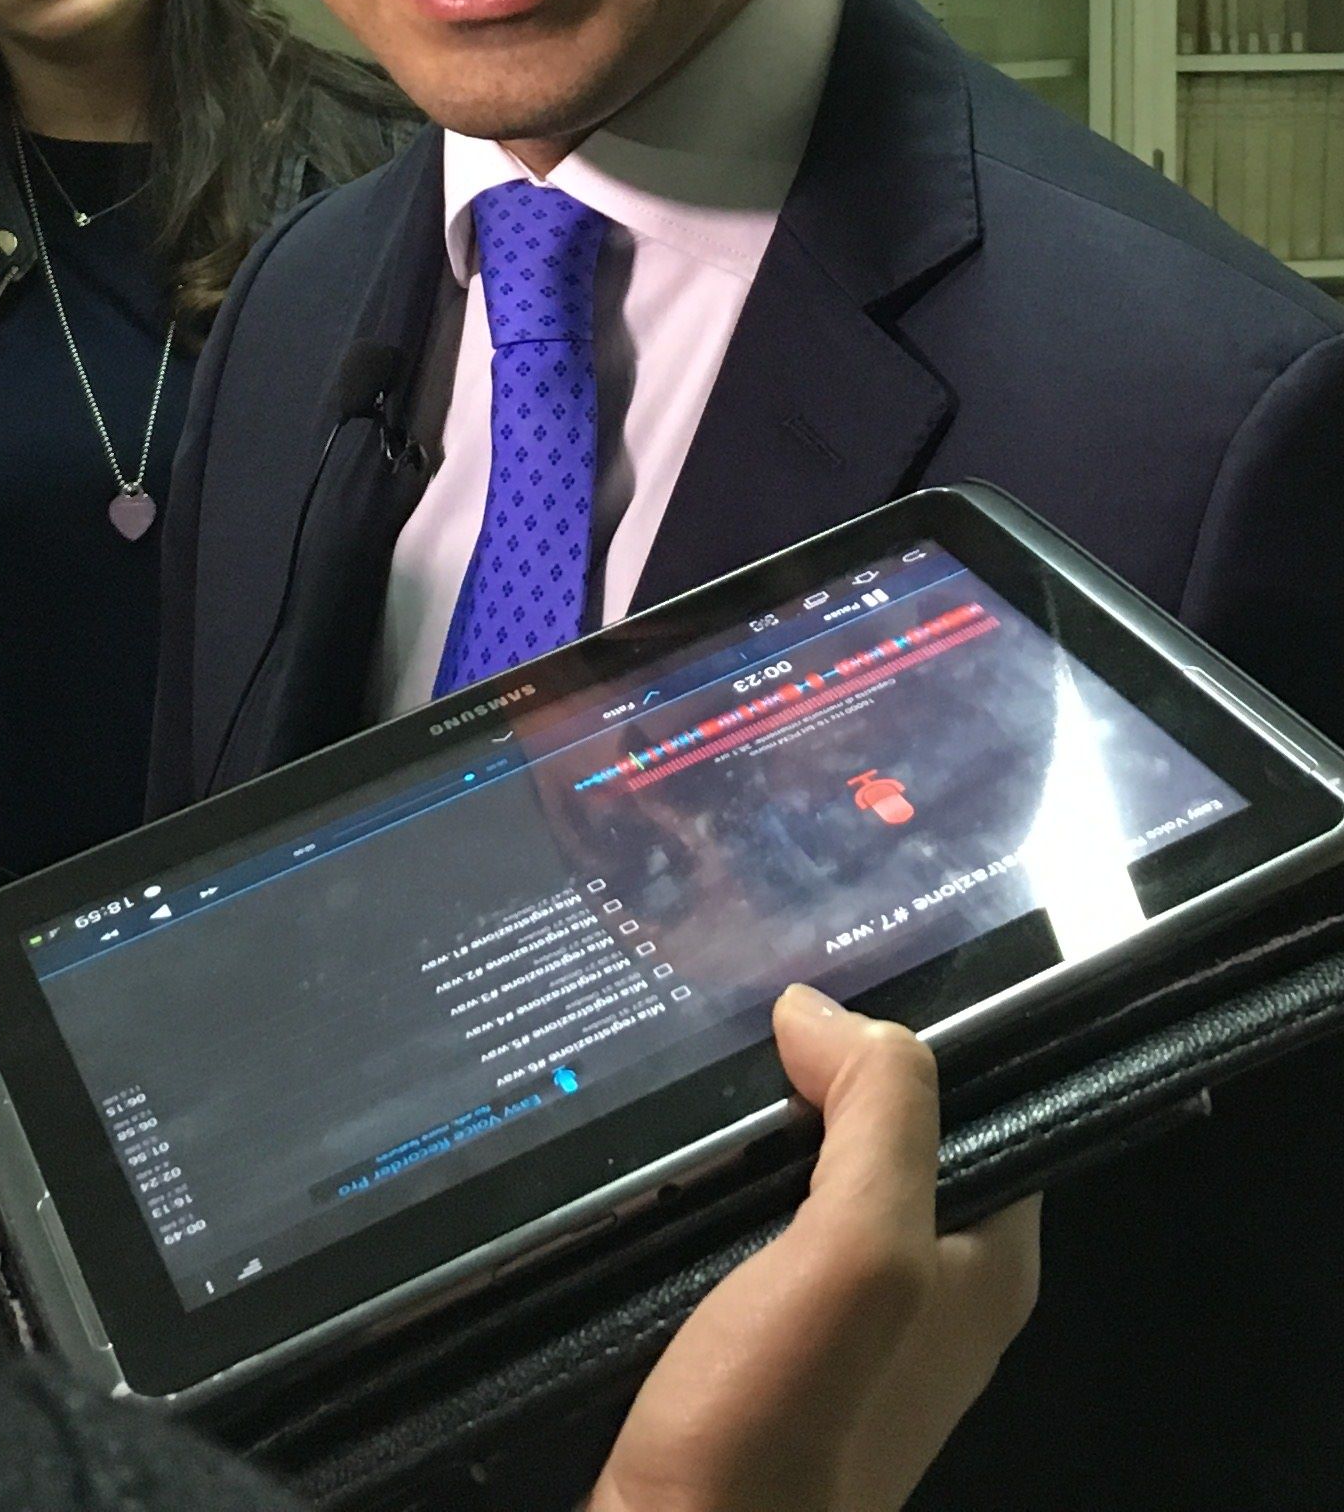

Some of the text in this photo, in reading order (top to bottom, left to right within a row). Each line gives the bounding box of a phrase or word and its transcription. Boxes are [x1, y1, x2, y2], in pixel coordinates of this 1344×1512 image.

[729, 658, 795, 693] 00:23
[429, 683, 537, 736] SAMSUNG
[600, 700, 637, 721] Fatto
[72, 894, 135, 930] 18:59
[468, 903, 556, 950] registrazione
[820, 851, 1027, 956] strazione #7.wav
[482, 924, 571, 971] registrazione
[497, 946, 587, 994] registrazione
[513, 968, 604, 1016] registrazione
[528, 990, 621, 1040] registrazione
[544, 1013, 638, 1064] registrazione
[336, 1091, 543, 1199] Easy Voice Recorder Pro
